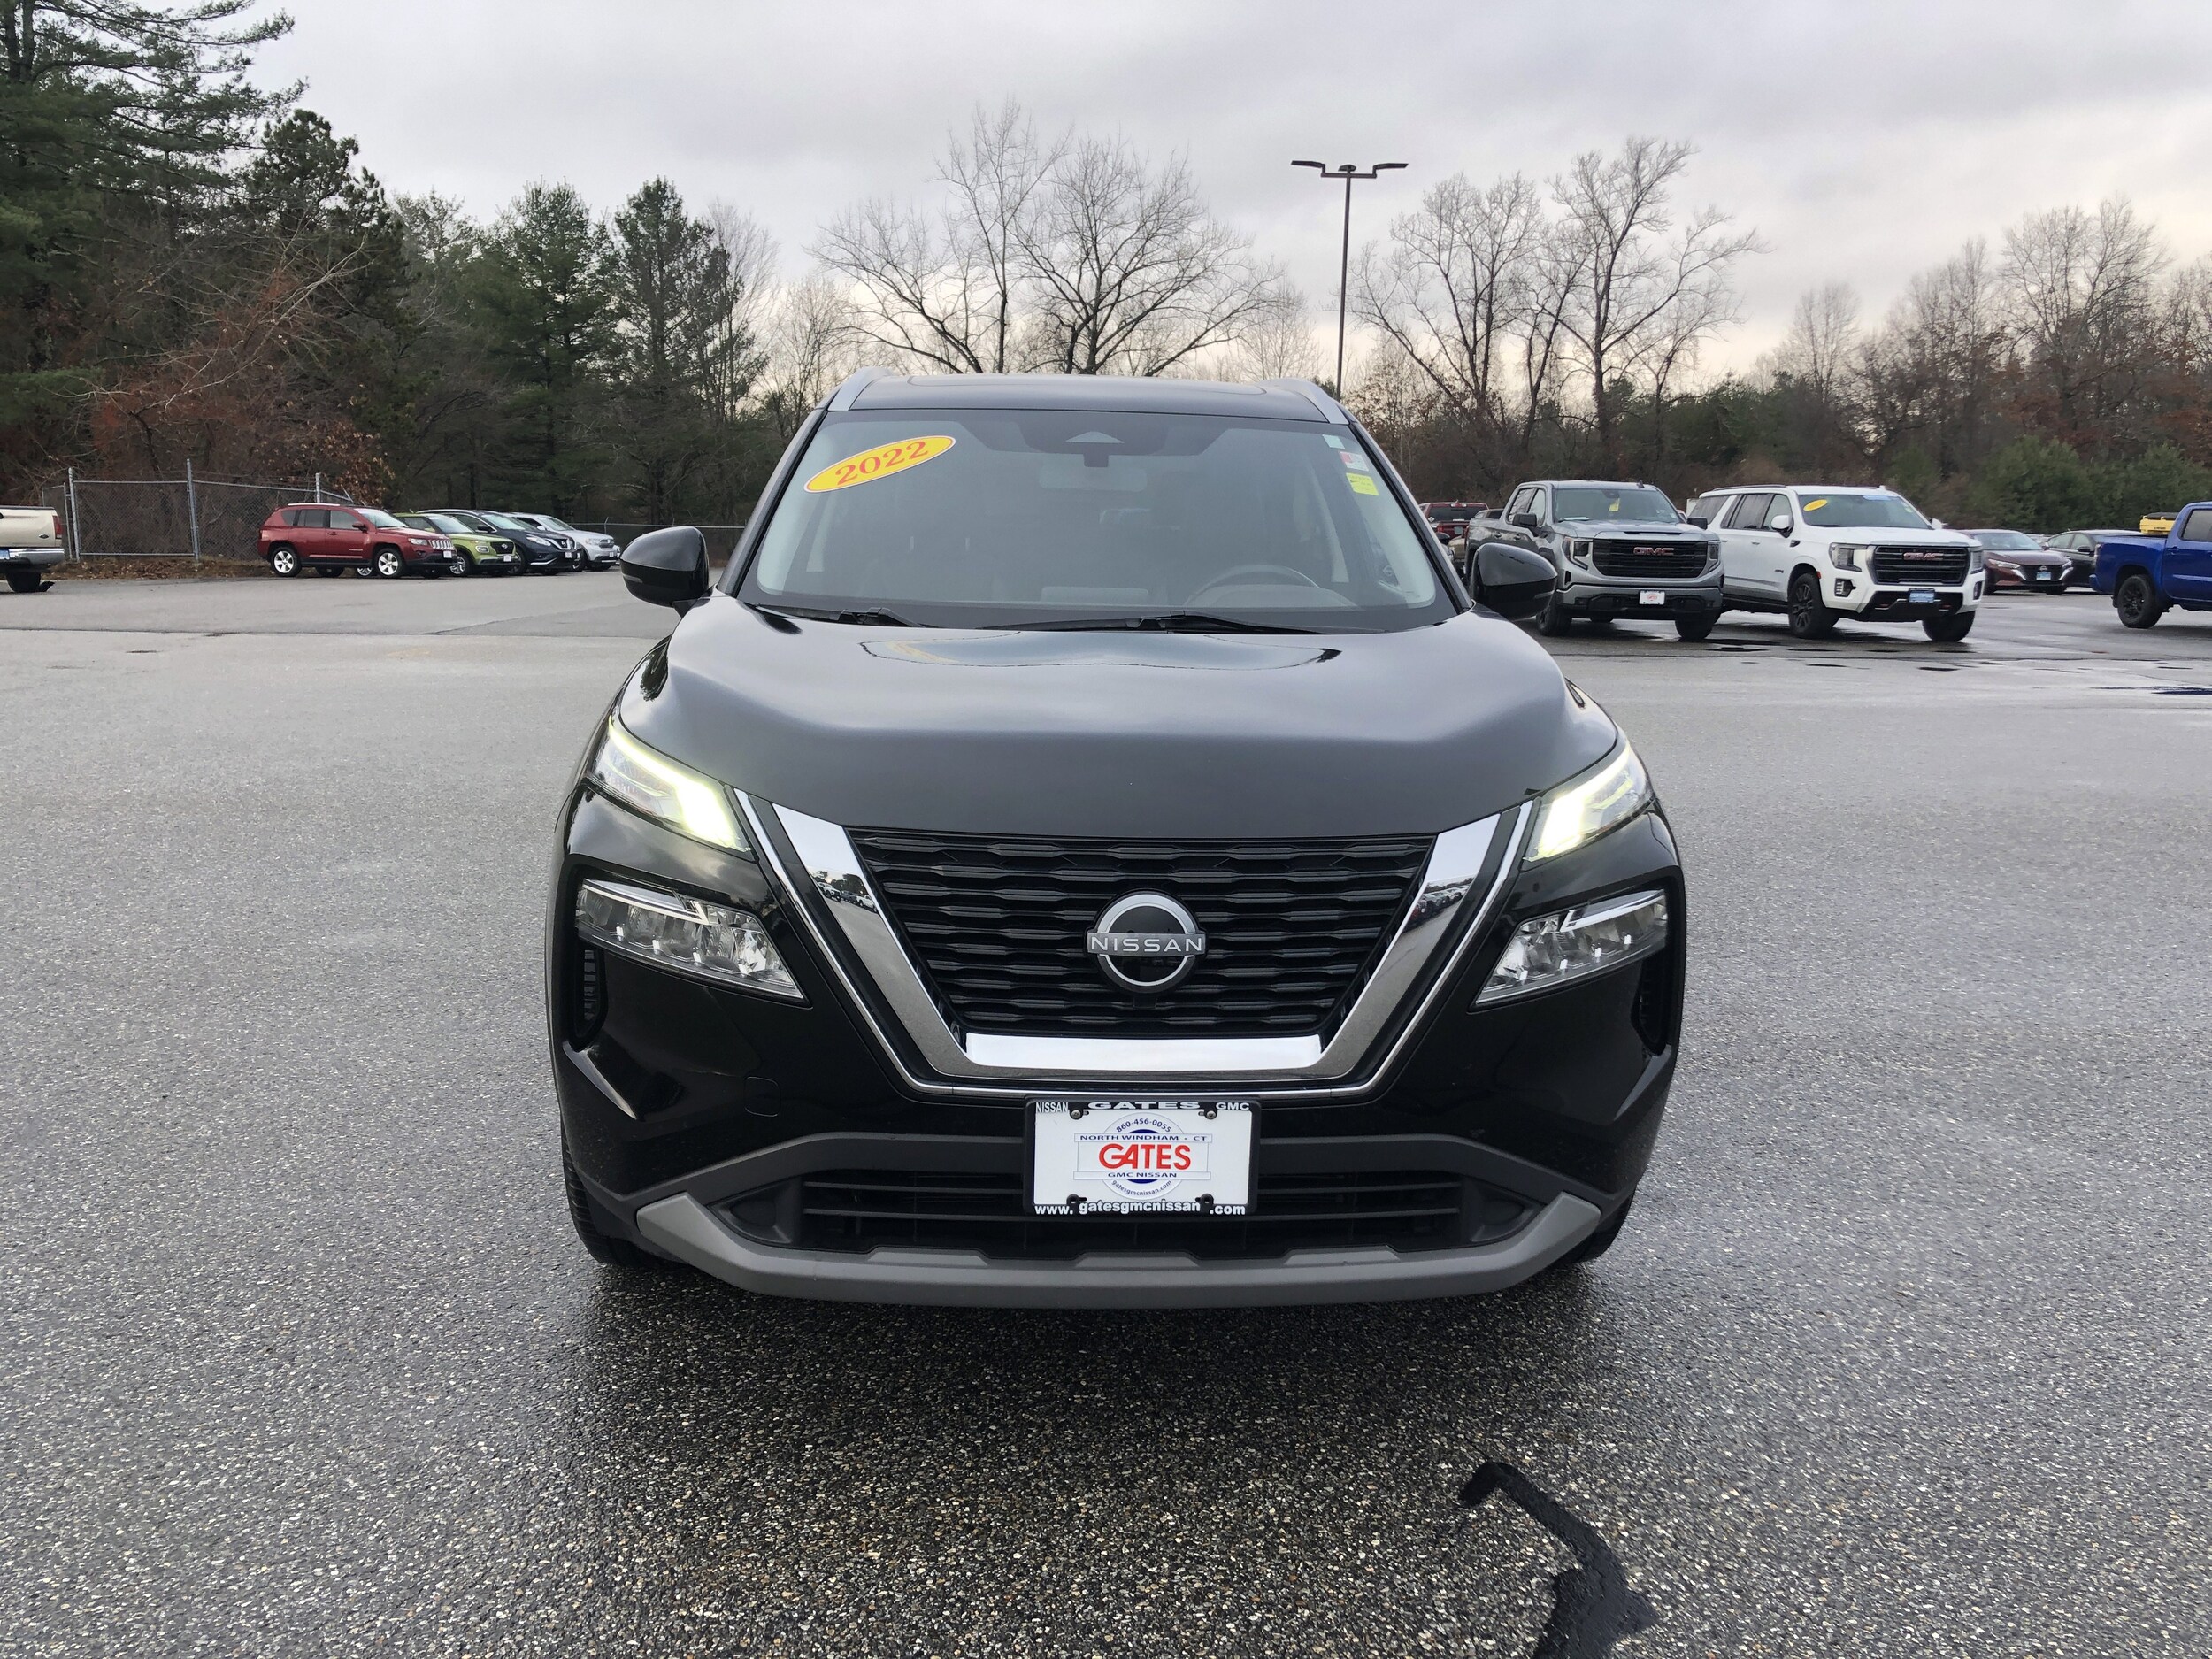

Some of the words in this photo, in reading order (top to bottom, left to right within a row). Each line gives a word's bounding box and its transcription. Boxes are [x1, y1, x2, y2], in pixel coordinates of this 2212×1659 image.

[834, 441, 929, 486] 2022
[1632, 546, 1674, 556] GMC
[1091, 936, 1202, 952] NISSAN
[1035, 1102, 1069, 1113] NISSAN
[1216, 1102, 1250, 1110] GMC
[1116, 1118, 1172, 1133] 860-456-0055
[1099, 1143, 1191, 1170] GATES
[1111, 1179, 1172, 1196] gatesgmcnissan.com
